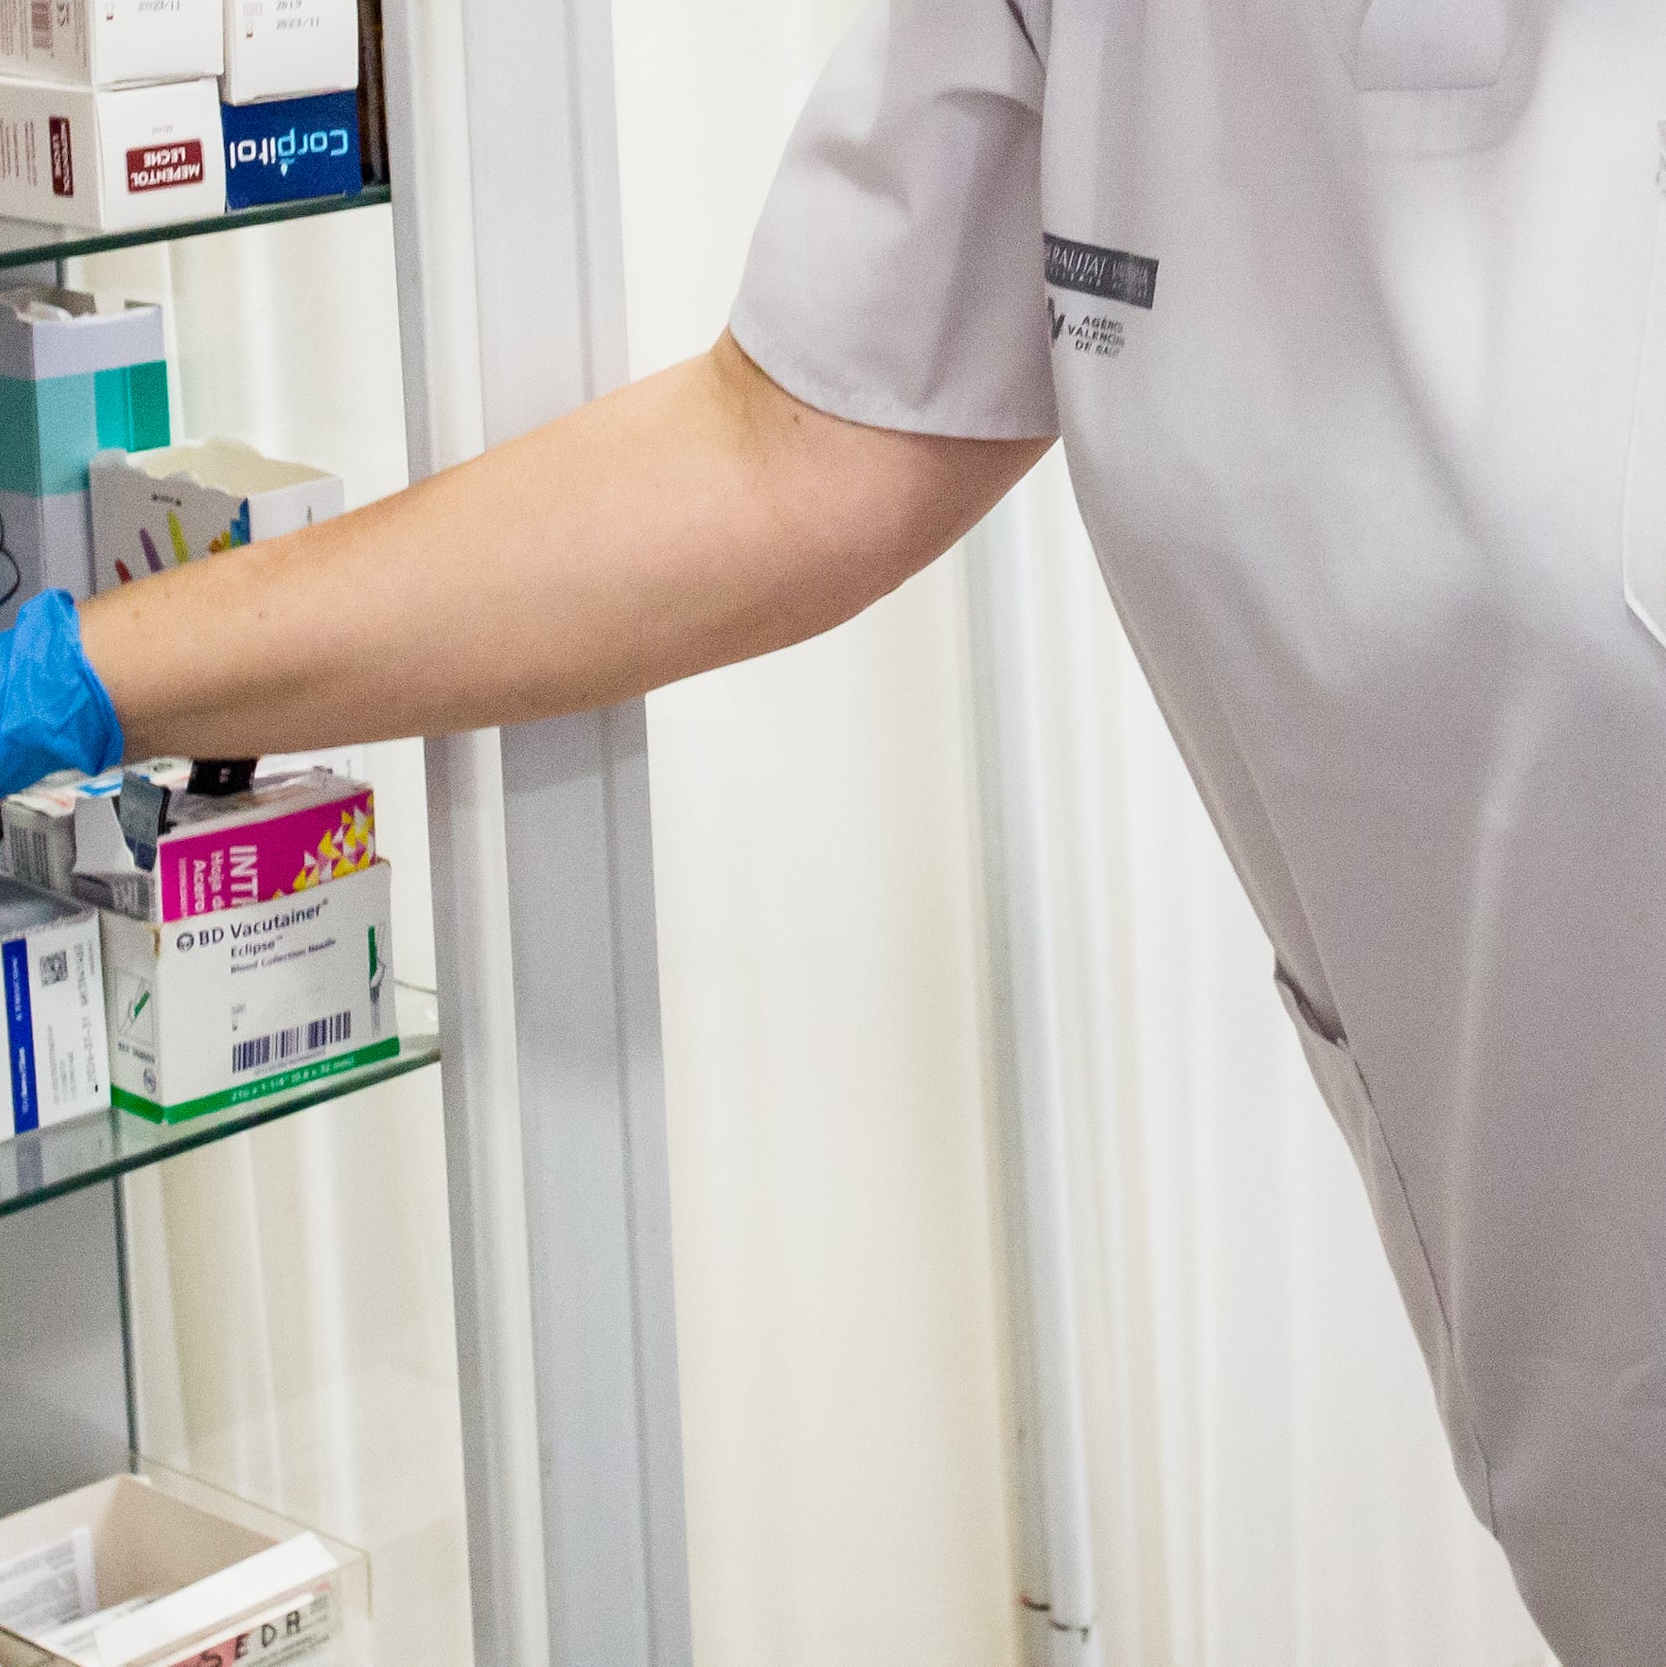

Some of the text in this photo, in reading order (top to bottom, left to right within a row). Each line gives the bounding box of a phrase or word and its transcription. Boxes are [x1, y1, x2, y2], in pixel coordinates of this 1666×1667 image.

[145, 142, 186, 165] LECHE
[230, 129, 349, 170] Corpitol
[131, 163, 200, 188] MEPENTOL
[199, 927, 224, 947] BD
